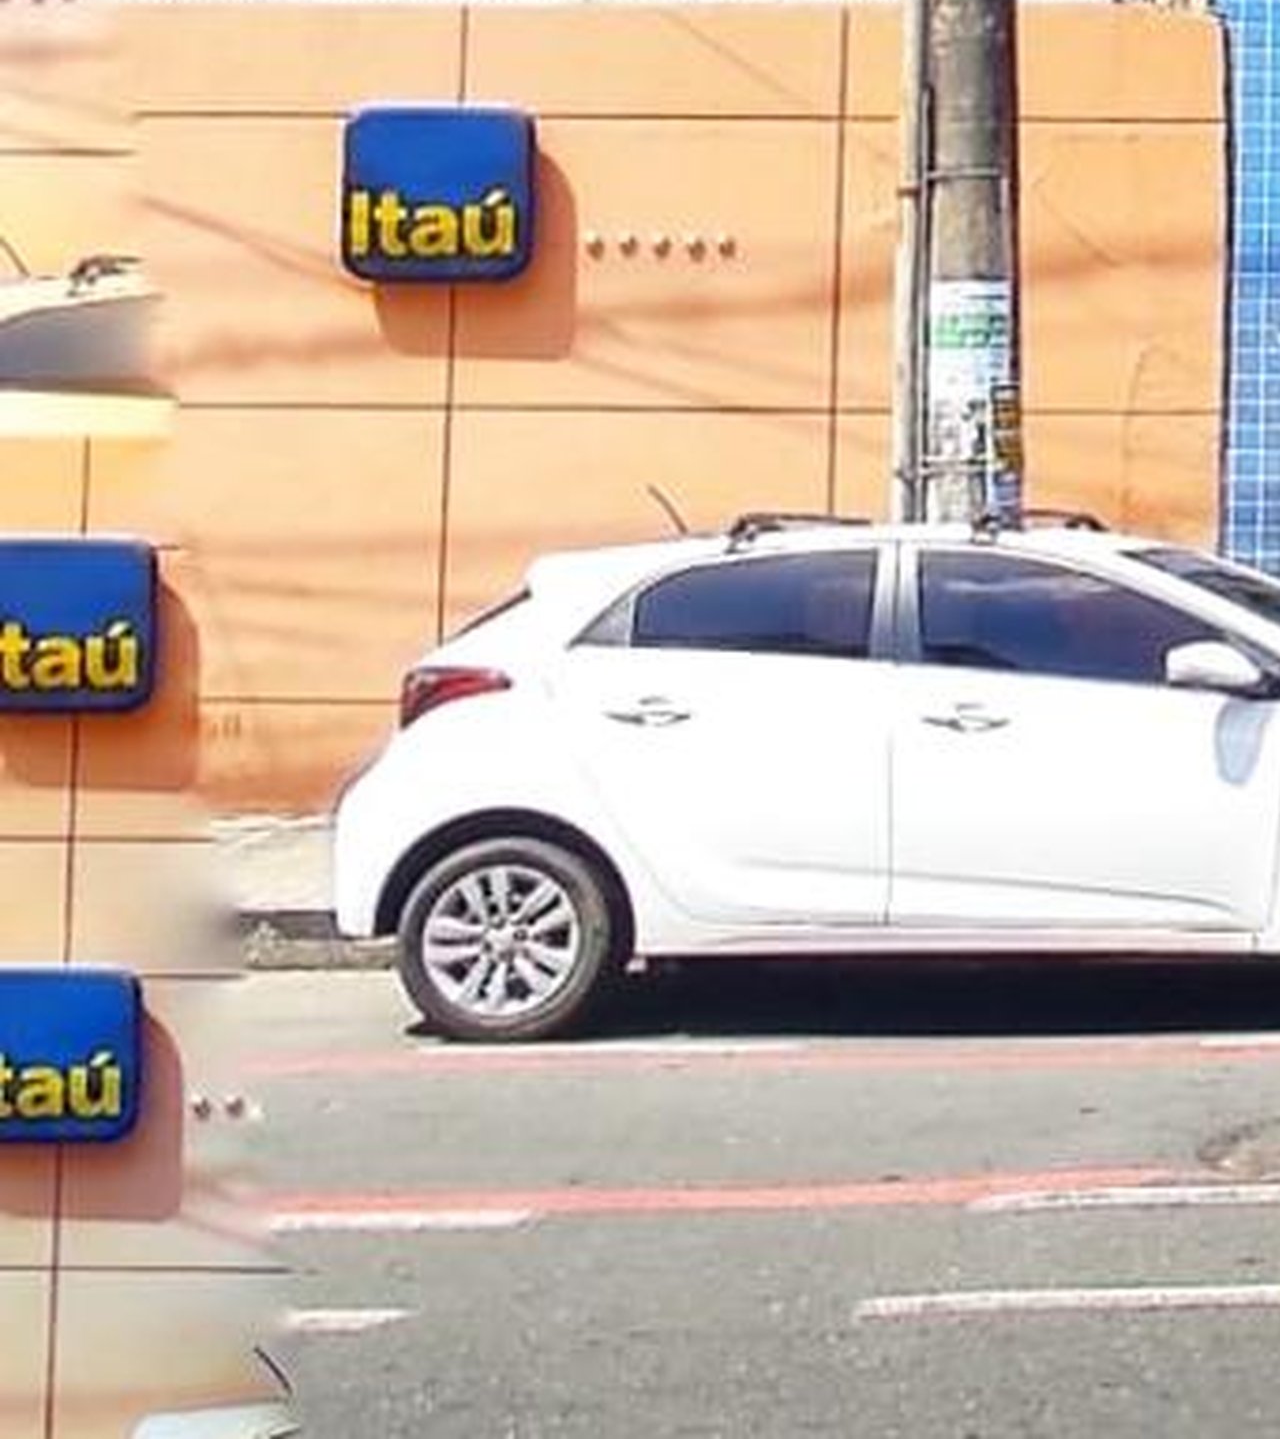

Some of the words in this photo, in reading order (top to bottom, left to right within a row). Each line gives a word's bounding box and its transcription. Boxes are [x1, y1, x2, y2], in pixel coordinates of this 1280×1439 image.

[348, 189, 516, 259] Itaú
[0, 621, 138, 689] taú
[0, 1050, 121, 1119] aú
